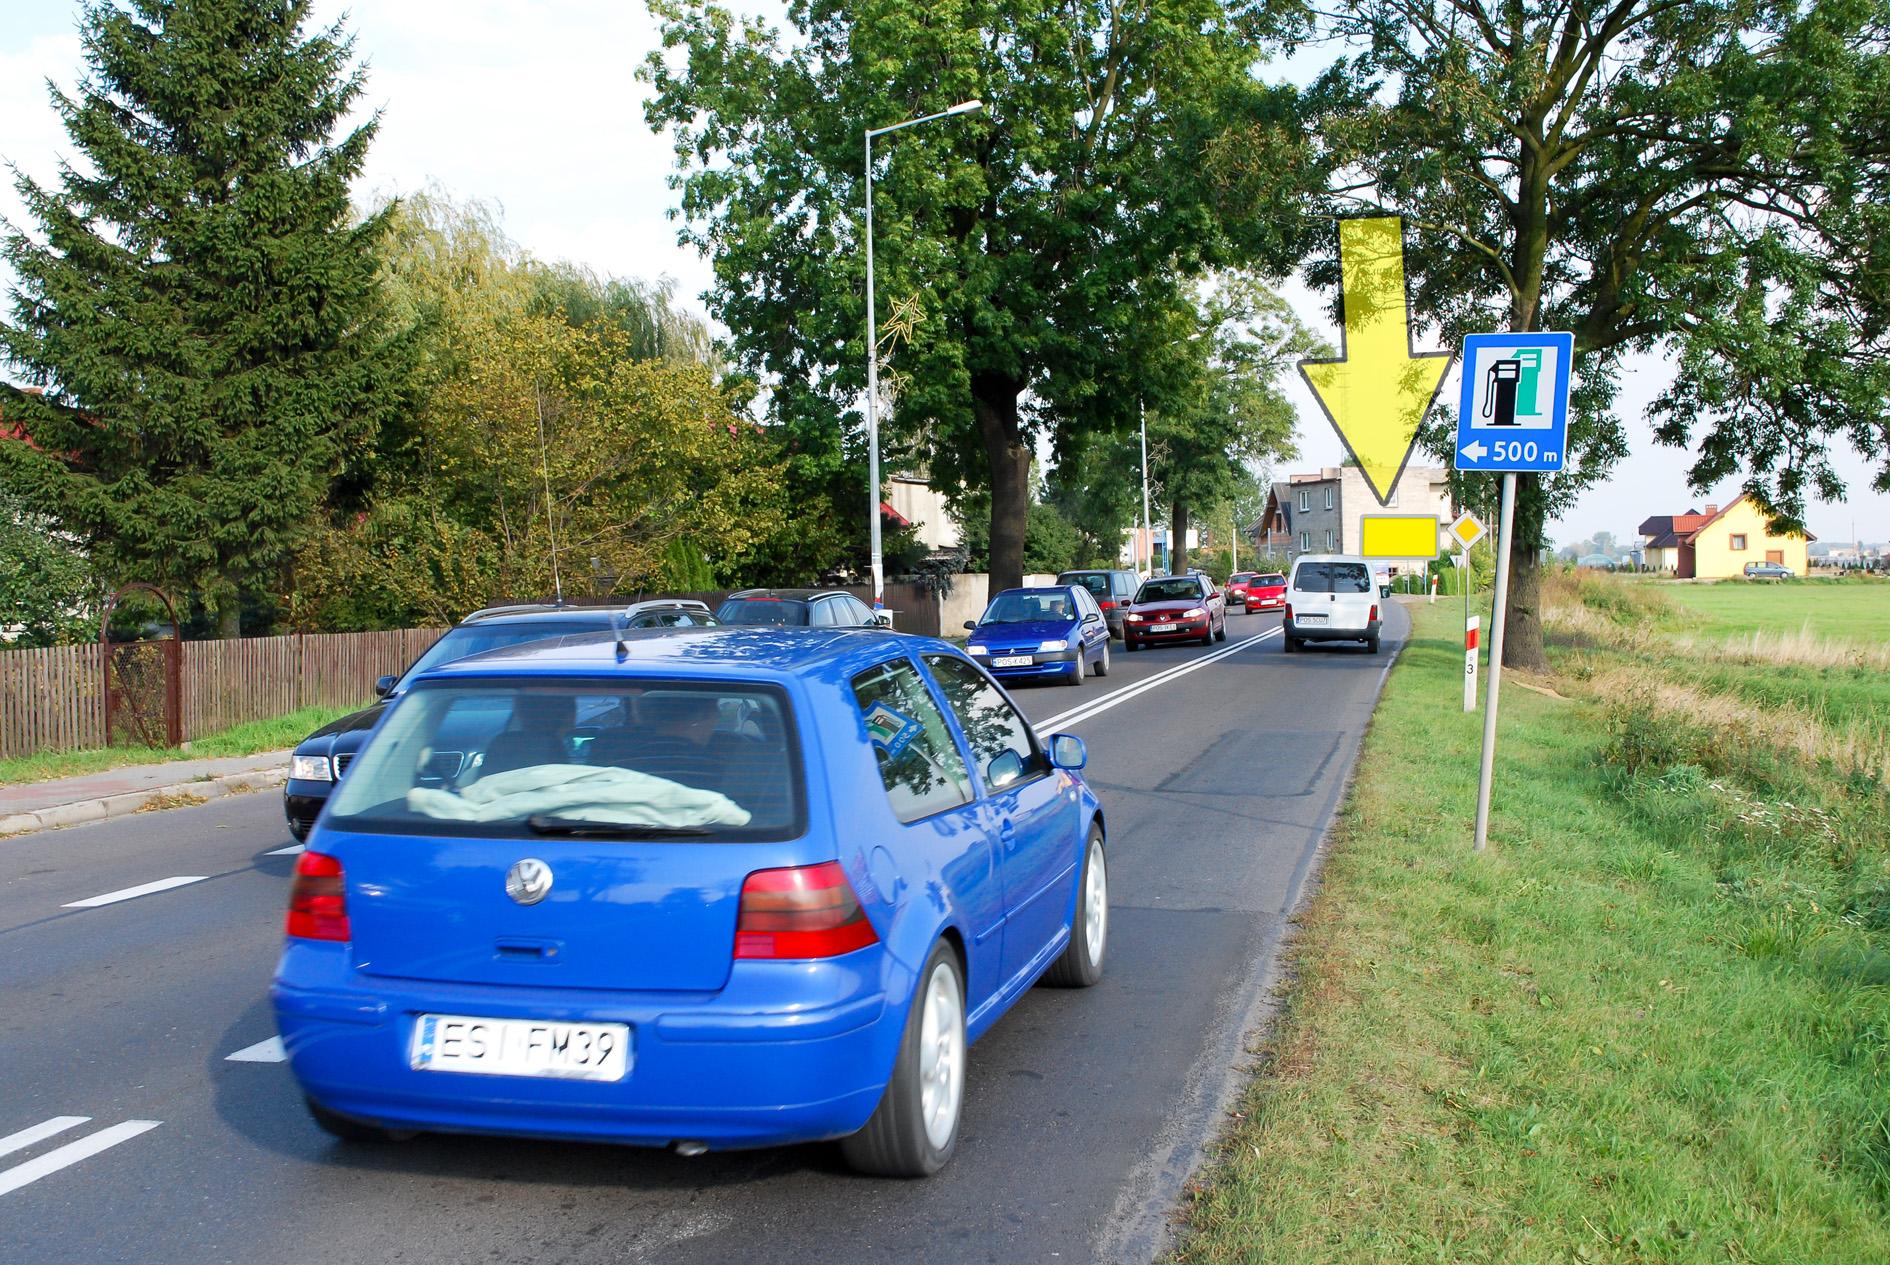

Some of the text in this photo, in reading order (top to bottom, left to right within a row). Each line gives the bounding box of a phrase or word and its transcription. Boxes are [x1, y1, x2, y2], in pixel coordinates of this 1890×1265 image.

[1493, 441, 1558, 462] 500 m
[996, 658, 1012, 666] POS
[1466, 664, 1474, 675] 3
[525, 1027, 615, 1066] FM39
